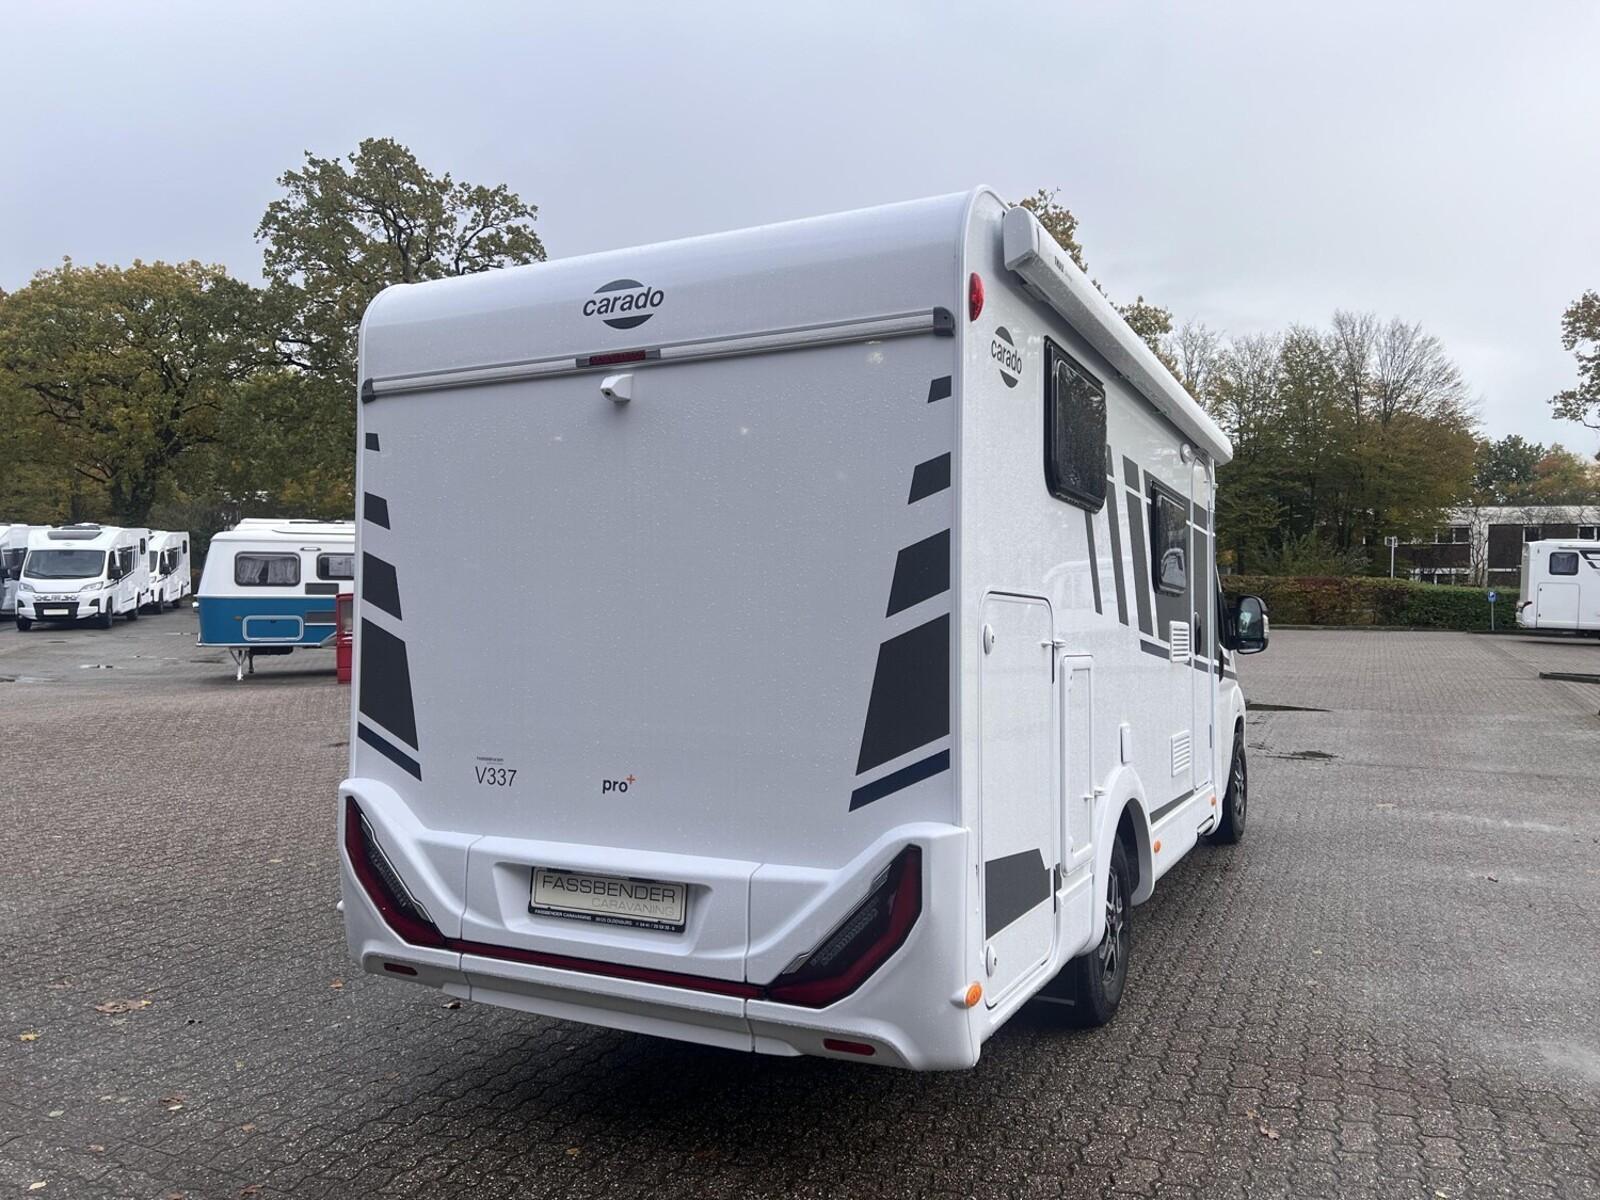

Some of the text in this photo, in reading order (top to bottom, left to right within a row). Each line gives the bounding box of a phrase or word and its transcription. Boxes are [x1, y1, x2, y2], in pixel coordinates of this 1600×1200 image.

[583, 286, 664, 316] carado
[991, 339, 1022, 374] carado
[475, 766, 517, 787] V337
[542, 875, 675, 903] FASSBENDER
[591, 897, 674, 916] CARAVANING
